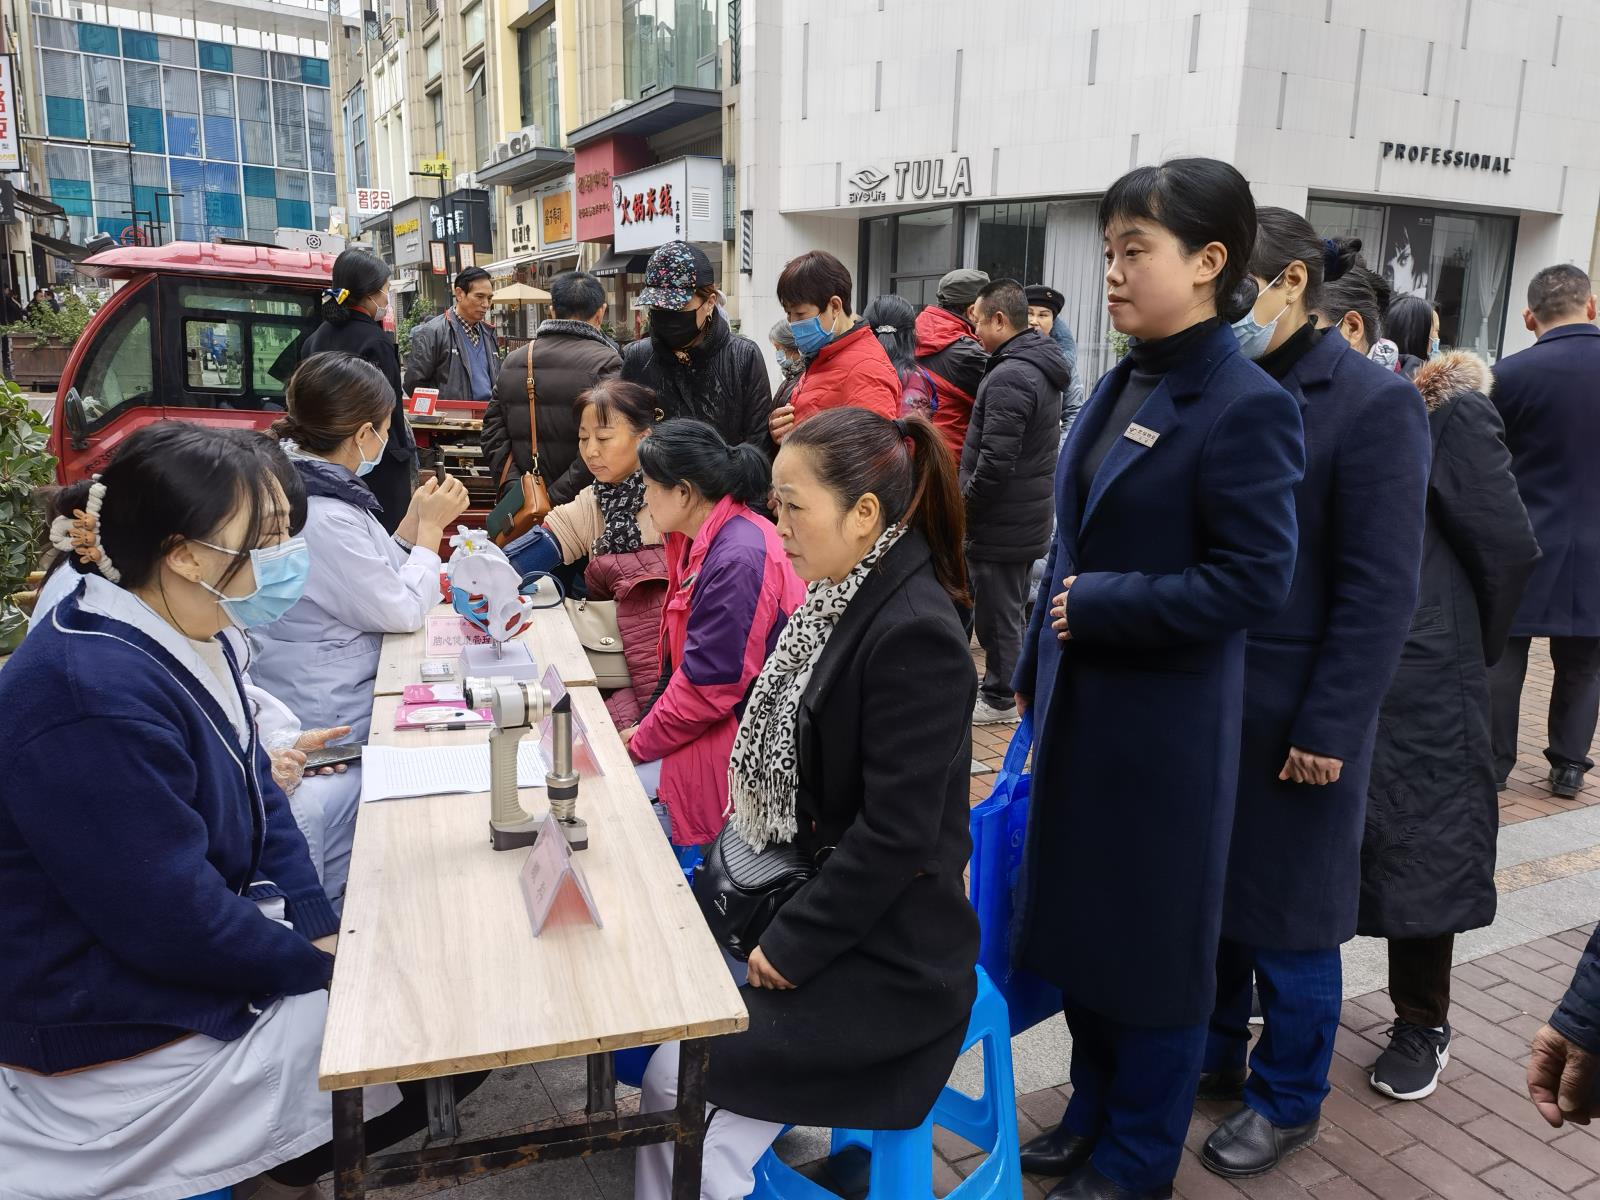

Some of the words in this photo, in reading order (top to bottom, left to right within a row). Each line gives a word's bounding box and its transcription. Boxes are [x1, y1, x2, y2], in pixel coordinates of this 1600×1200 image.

[1383, 142, 1512, 174] PROFESSIONAL
[894, 156, 972, 199] TULA
[358, 190, 391, 210] 奢侈品
[620, 183, 673, 225] 火锅米线
